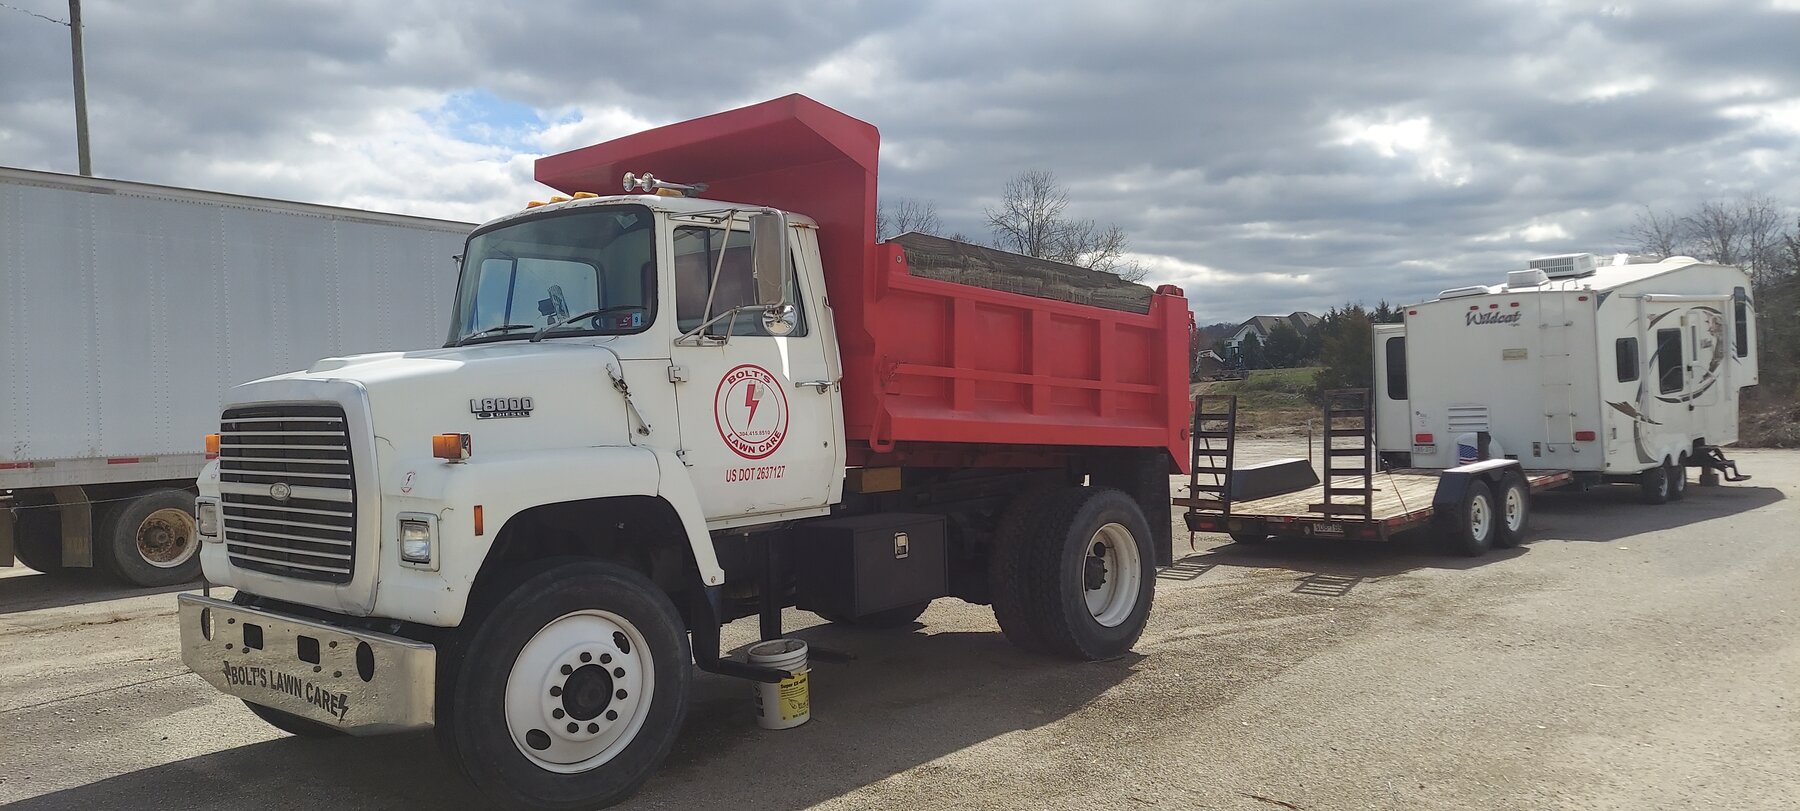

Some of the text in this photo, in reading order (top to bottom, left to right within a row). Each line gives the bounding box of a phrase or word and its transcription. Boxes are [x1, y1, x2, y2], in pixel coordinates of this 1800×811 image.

[1465, 311, 1522, 326] Wildcat
[727, 370, 771, 385] BOLT'S
[470, 397, 534, 413] L8000
[727, 431, 781, 454] LAWN CARE
[726, 465, 786, 482] US DOT 2637127
[231, 666, 339, 717] BOLT'S LAWN CARE
